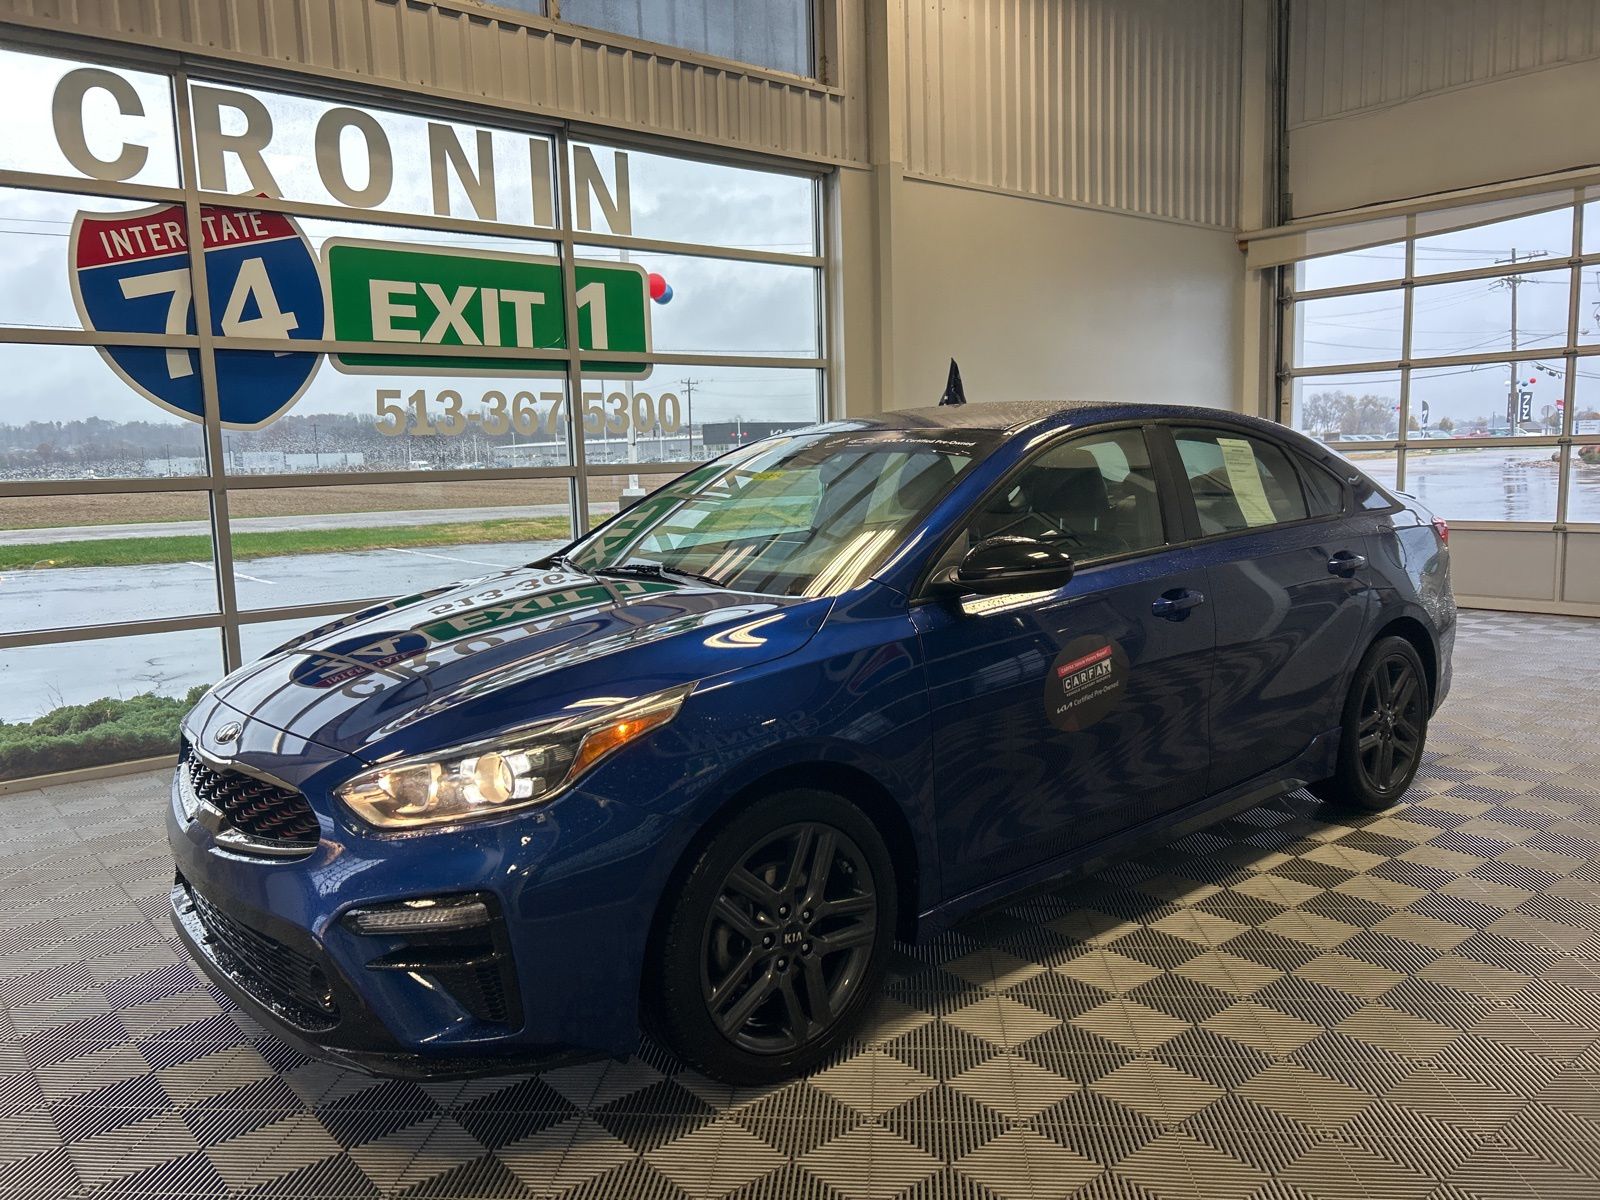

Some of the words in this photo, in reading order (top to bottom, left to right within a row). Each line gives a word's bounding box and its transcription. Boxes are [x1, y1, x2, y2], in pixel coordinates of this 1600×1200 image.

[52, 68, 632, 236] CRONIN
[99, 211, 269, 258] INTERTATE
[118, 257, 299, 379] 74
[369, 279, 545, 348] EXIT
[576, 282, 608, 349] 1
[375, 389, 681, 436] 513-3675300
[1064, 660, 1111, 691] CARFAX
[1074, 692, 1094, 706] Certified
[1094, 680, 1119, 698] Pre-Owned
[784, 931, 802, 944] KIA
